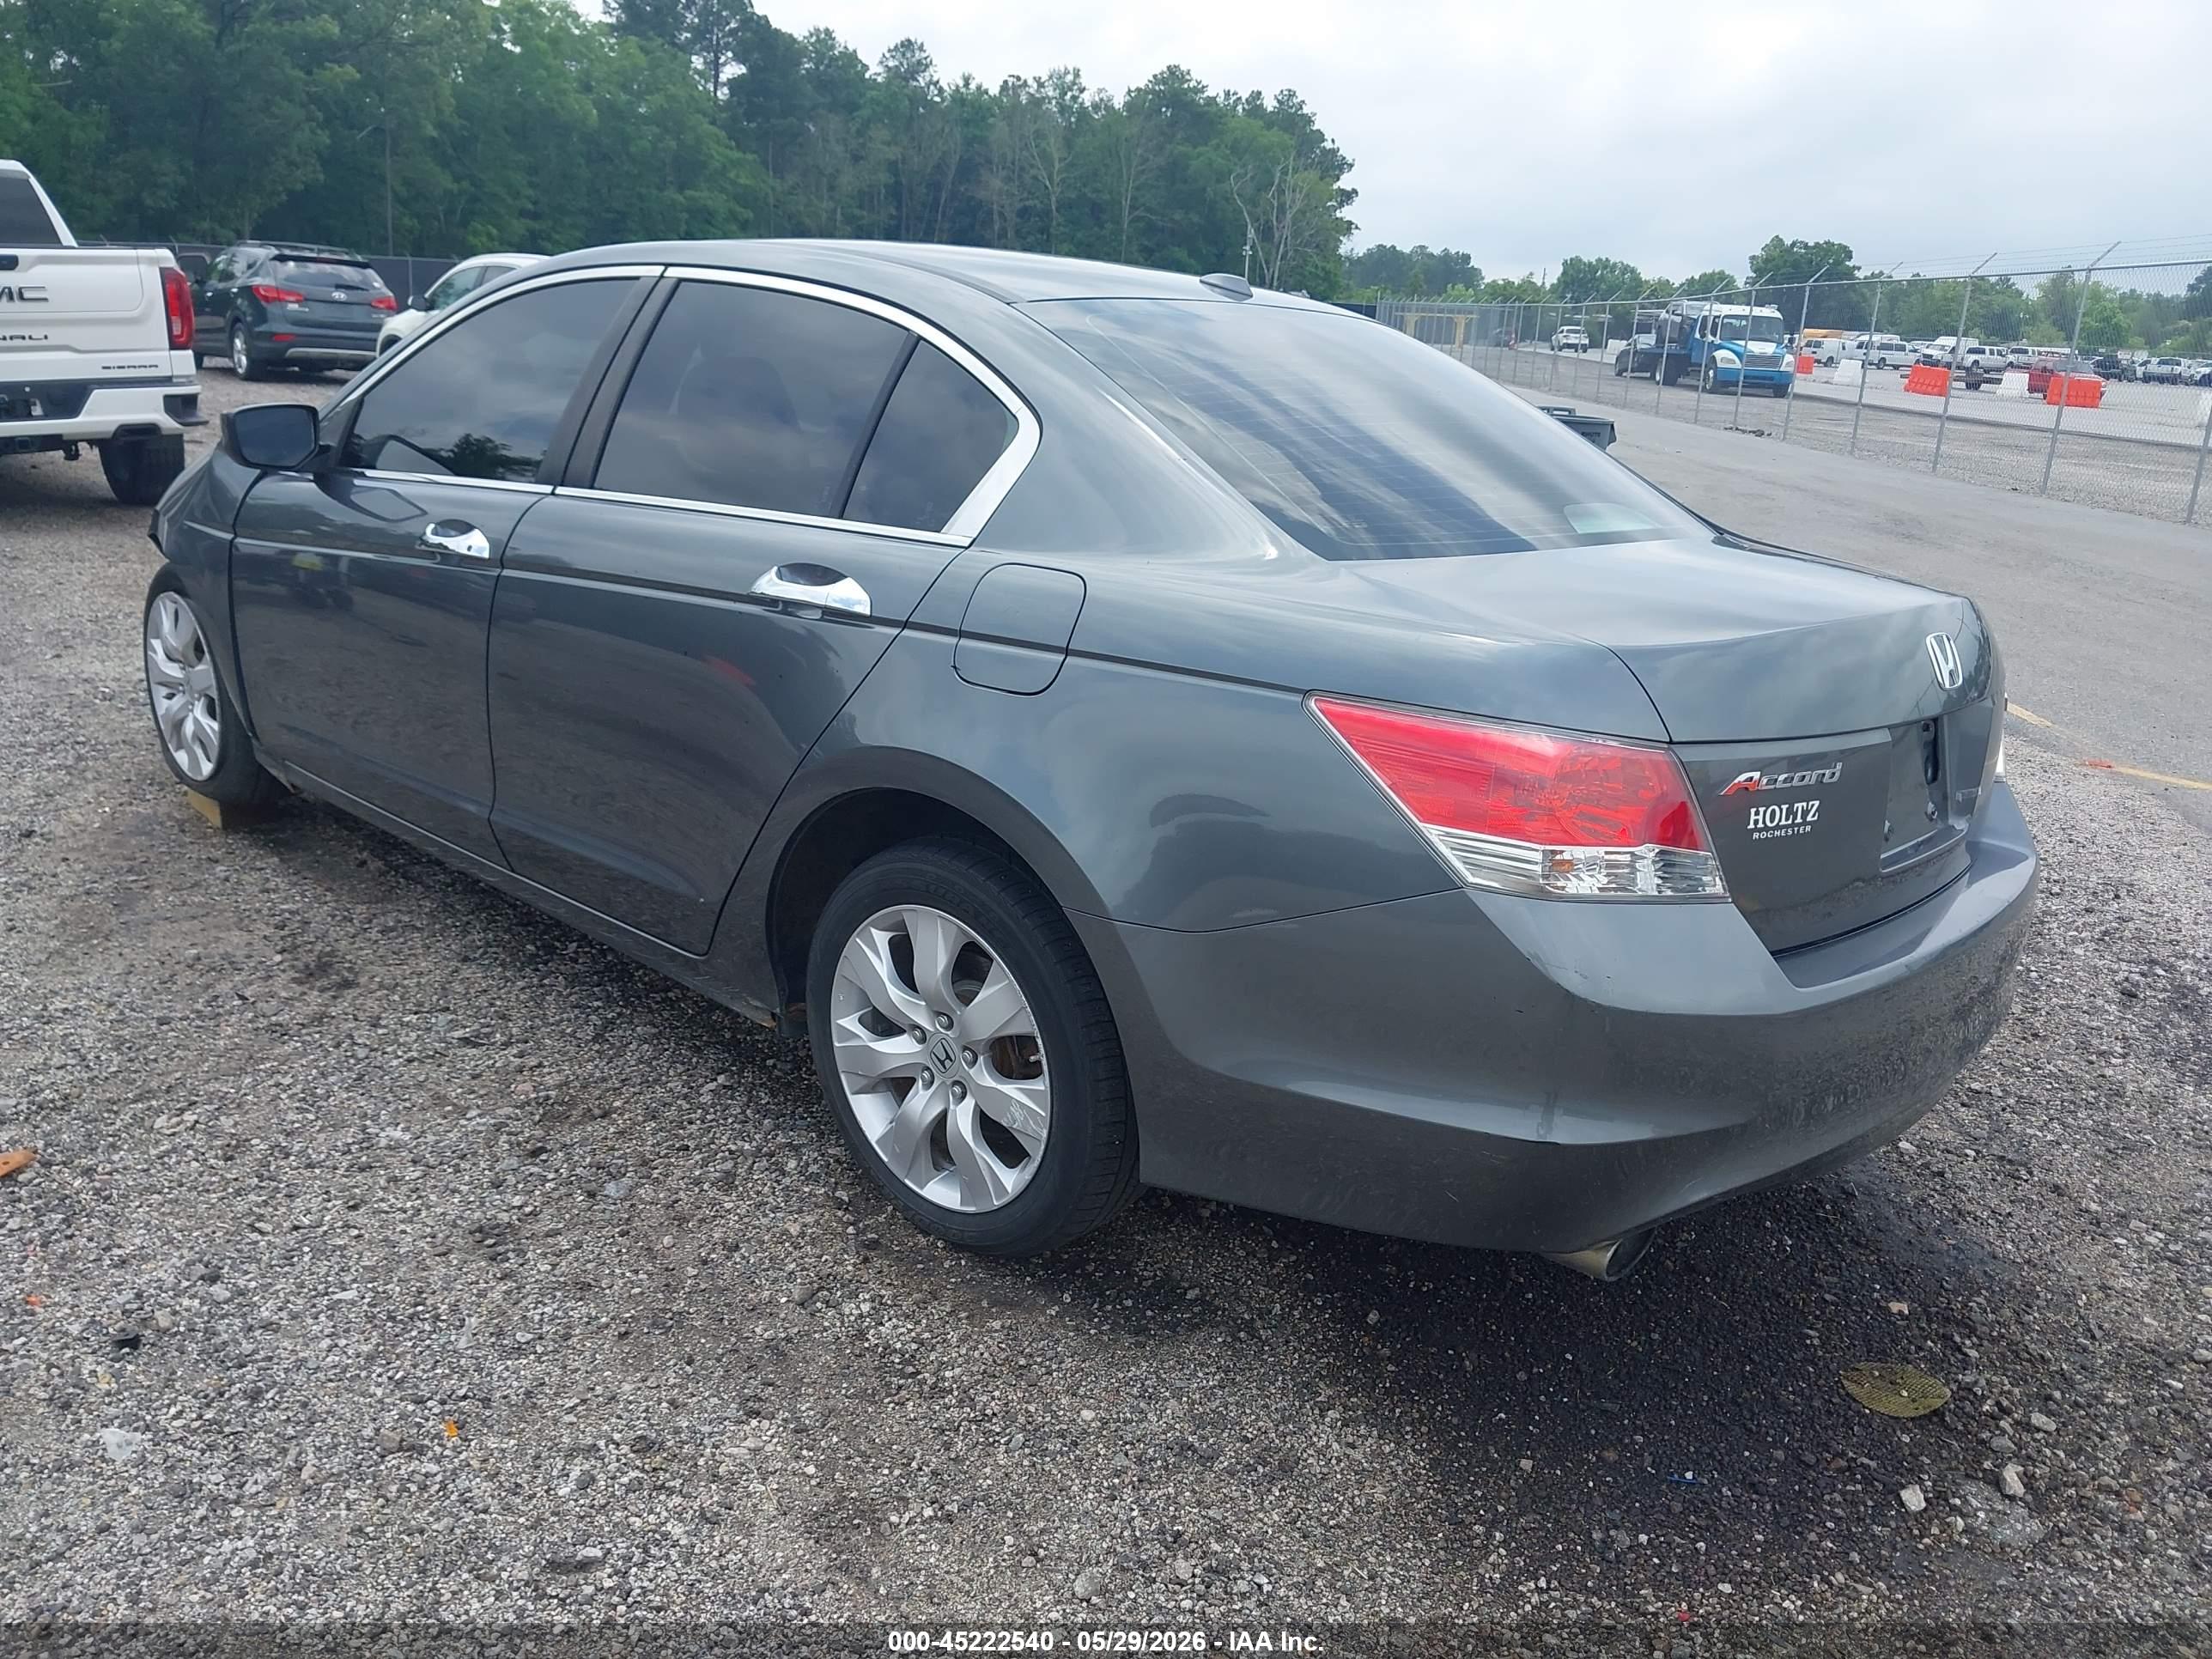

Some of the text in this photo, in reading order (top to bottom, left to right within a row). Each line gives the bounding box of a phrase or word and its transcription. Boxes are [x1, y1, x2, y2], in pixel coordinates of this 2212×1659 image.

[1717, 762, 1843, 796] Accord
[1747, 800, 1820, 829] HOLTZ
[1752, 825, 1812, 840] ROCHESTER
